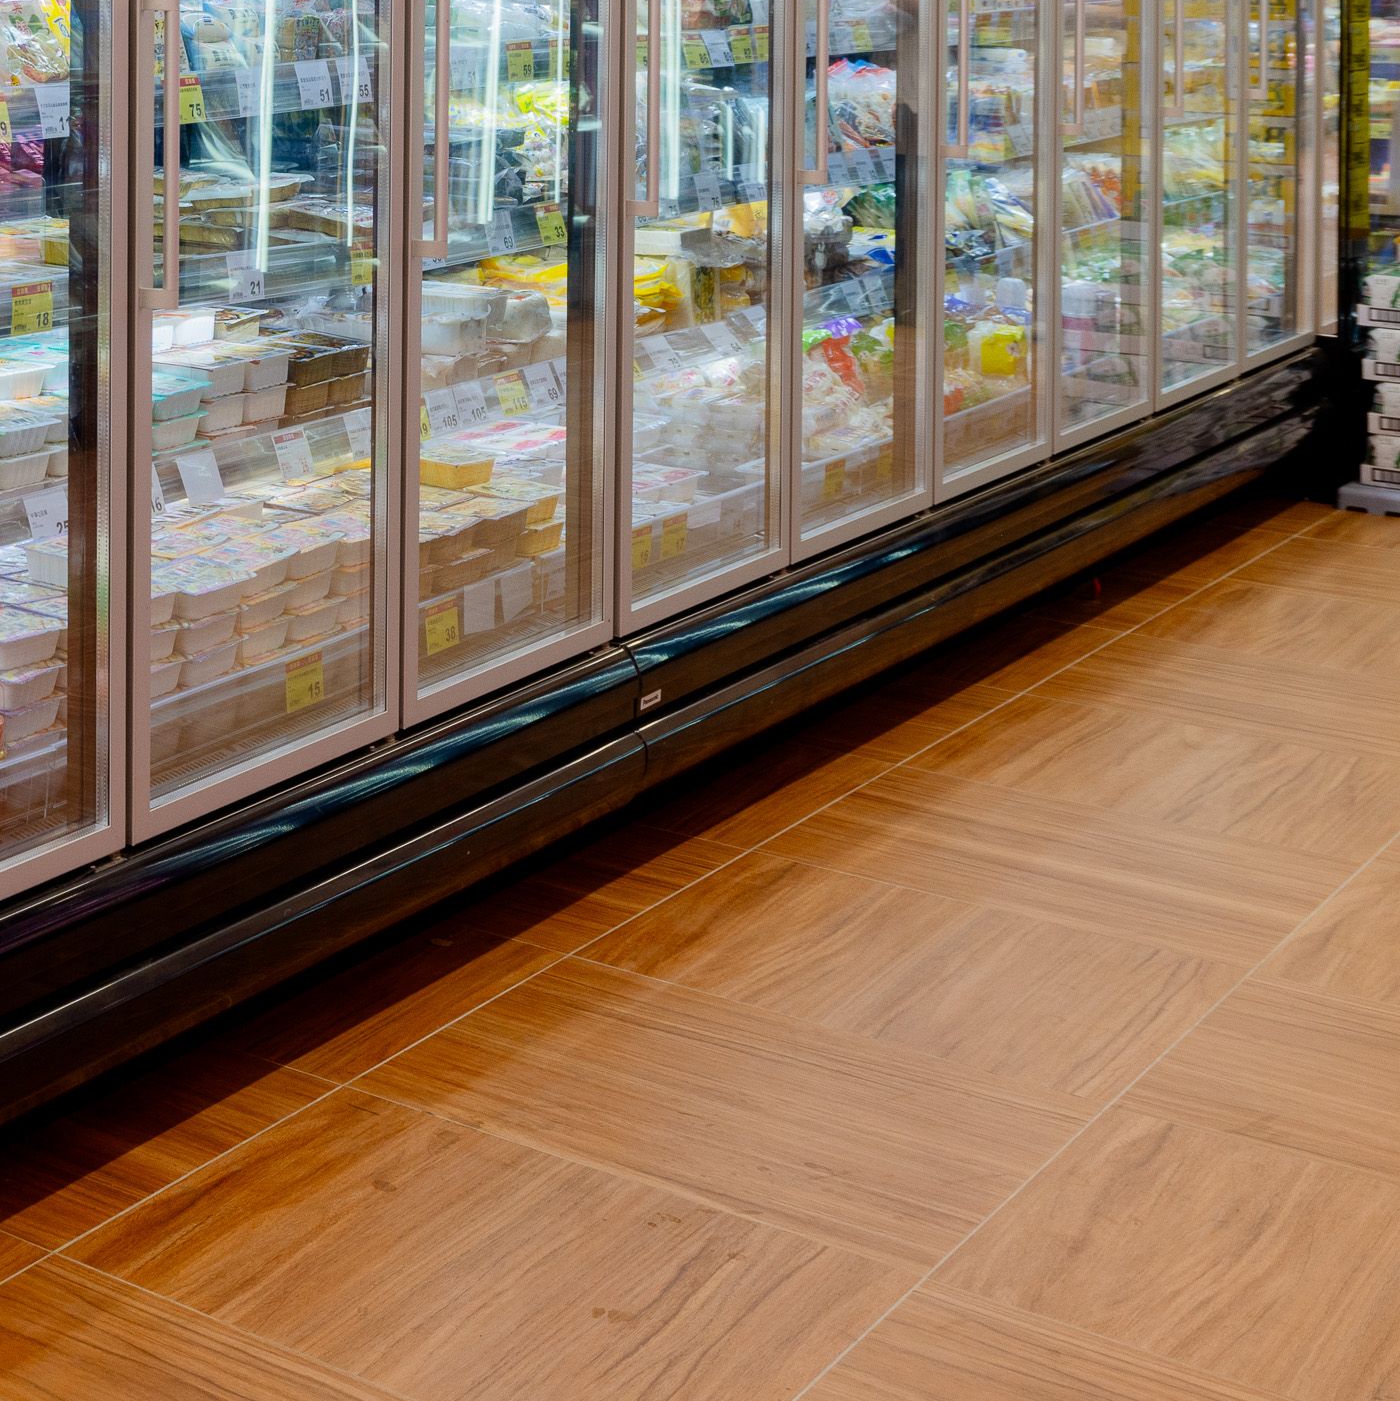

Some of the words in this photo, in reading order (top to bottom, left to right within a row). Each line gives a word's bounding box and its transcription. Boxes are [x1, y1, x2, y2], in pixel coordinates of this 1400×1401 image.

[189, 102, 203, 118] 75
[250, 281, 262, 296] 21
[35, 311, 49, 328] 18
[442, 413, 459, 428] 105
